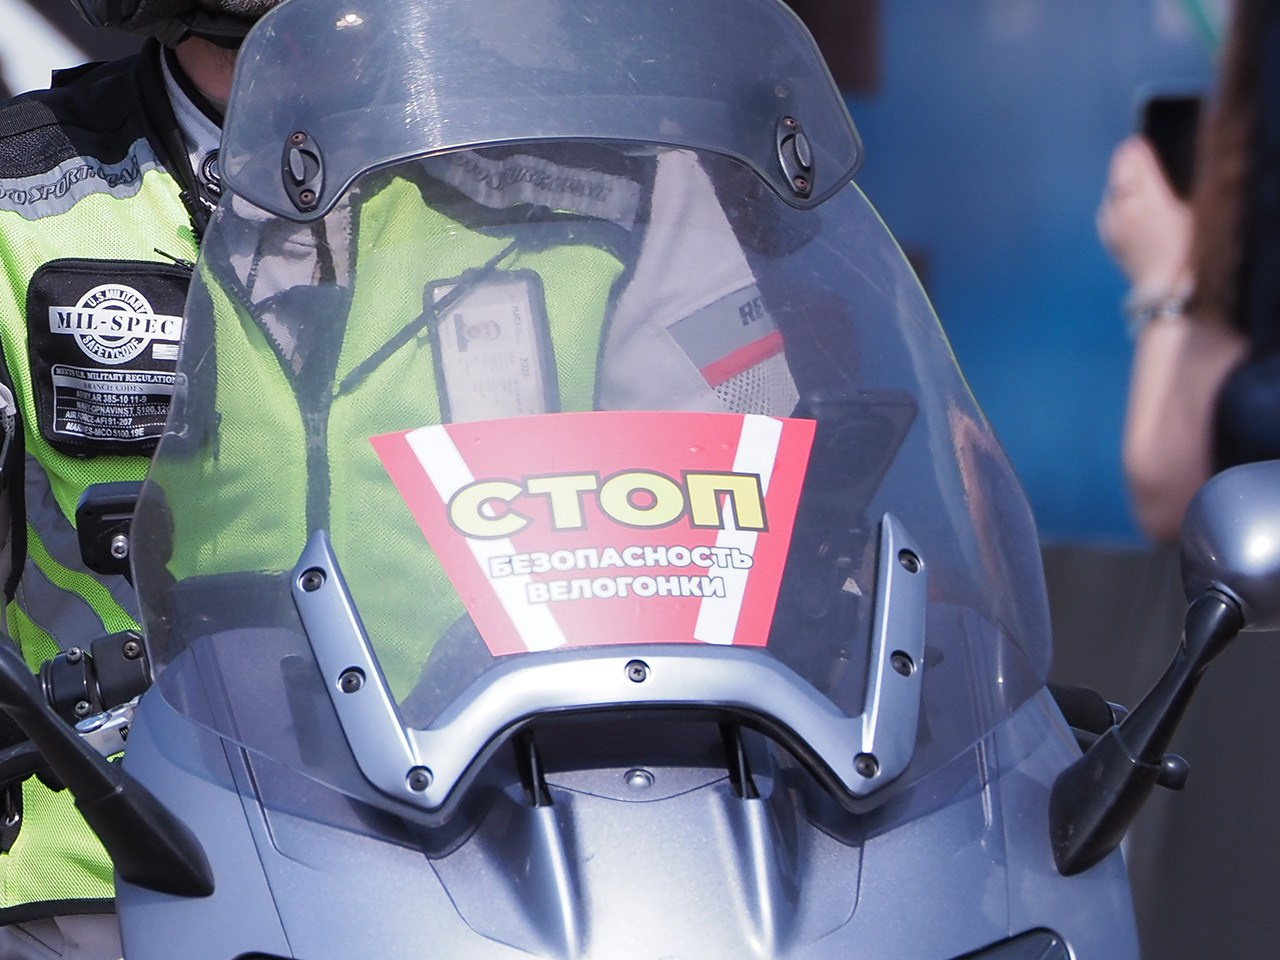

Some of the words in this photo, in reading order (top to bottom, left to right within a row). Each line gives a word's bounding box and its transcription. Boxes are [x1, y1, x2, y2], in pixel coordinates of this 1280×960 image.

[56, 311, 175, 336] MIL-SPEC
[86, 371, 125, 382] MILITARY
[83, 382, 113, 392] BRANCH
[115, 384, 144, 392] CODES
[102, 394, 129, 404] 385-10
[107, 417, 133, 426] 91-207
[113, 427, 145, 438] 5100.19E
[447, 468, 769, 540] СТОП
[488, 545, 754, 579] БЕЗОПАСНОСТЬ
[525, 575, 726, 606] ВЕЛОГОНКИ
